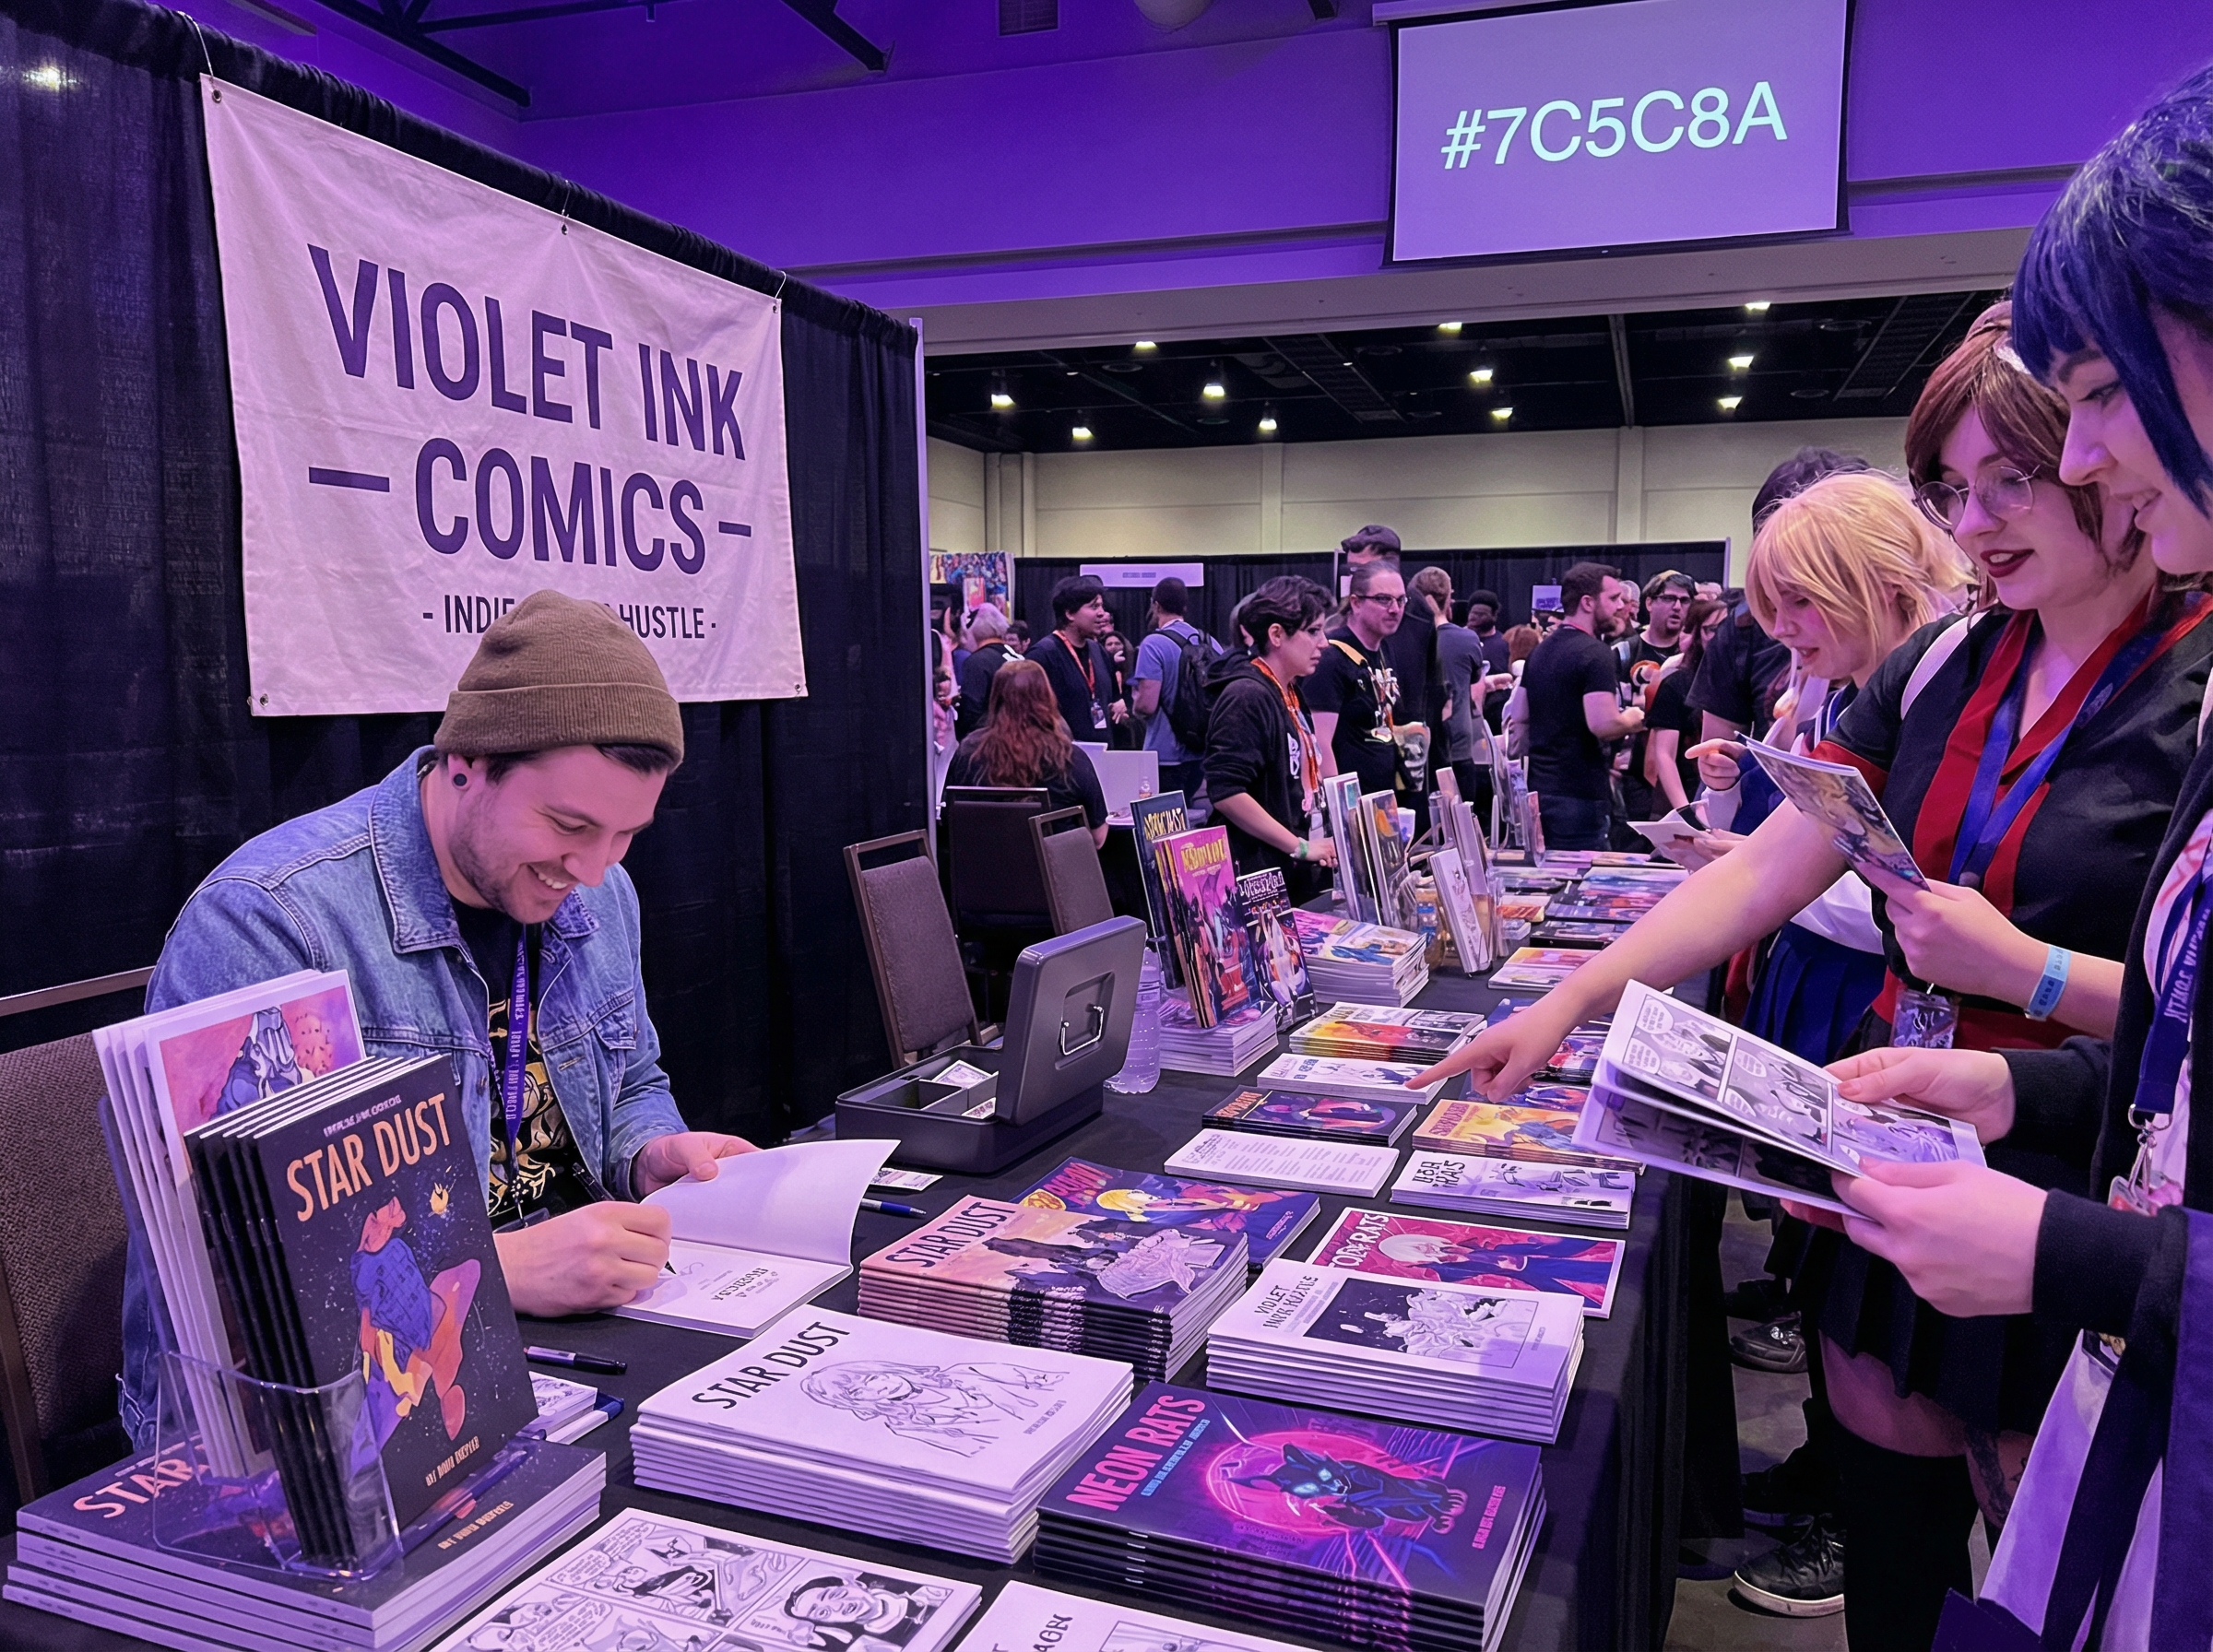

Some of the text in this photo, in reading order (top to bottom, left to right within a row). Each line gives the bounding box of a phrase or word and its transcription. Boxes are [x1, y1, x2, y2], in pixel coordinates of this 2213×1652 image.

[1441, 81, 1788, 170] #7C5C8A
[307, 243, 746, 461] VIOLET INK
[415, 437, 705, 575] COMICS
[619, 604, 705, 639] HUSTLE
[287, 1134, 373, 1222] STAR
[373, 1092, 450, 1177] DUST
[885, 1201, 1017, 1268] STAR DUST
[1349, 1213, 1390, 1244] RATS
[692, 1321, 850, 1410] STAR DUST
[73, 1459, 209, 1518] STAR
[1065, 1445, 1163, 1512] NEON
[1125, 1395, 1206, 1447] RATS
